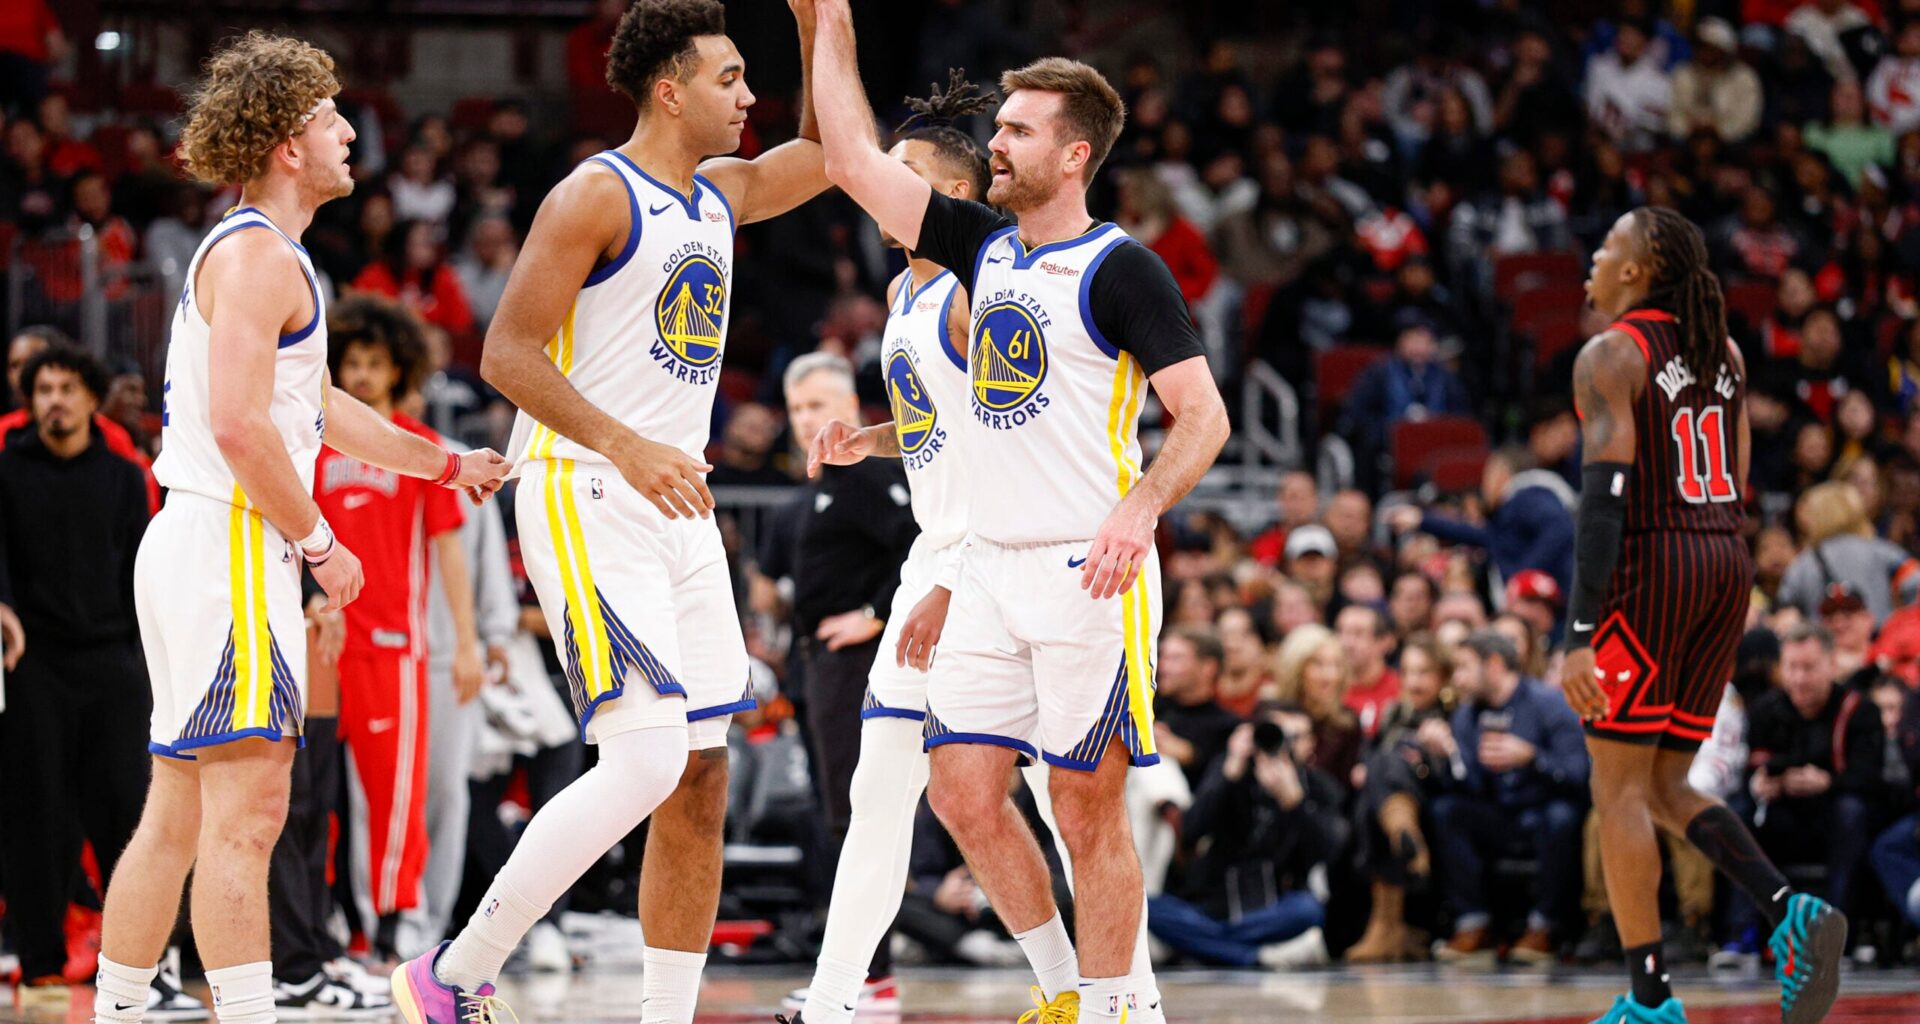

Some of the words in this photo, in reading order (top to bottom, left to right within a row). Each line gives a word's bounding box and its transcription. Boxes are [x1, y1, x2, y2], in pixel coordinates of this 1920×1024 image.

[663, 241, 704, 273] GOLDEN
[707, 245, 730, 281] STATE
[1039, 261, 1080, 277] Rakuten
[703, 284, 723, 316] 32
[973, 288, 1016, 320] GOLDEN
[1018, 292, 1052, 330] STATE
[649, 338, 722, 385] WARRIO
[1008, 329, 1031, 360] 61
[906, 373, 920, 401] 3
[903, 427, 947, 471] RRIORS
[1671, 405, 1738, 503] 11
